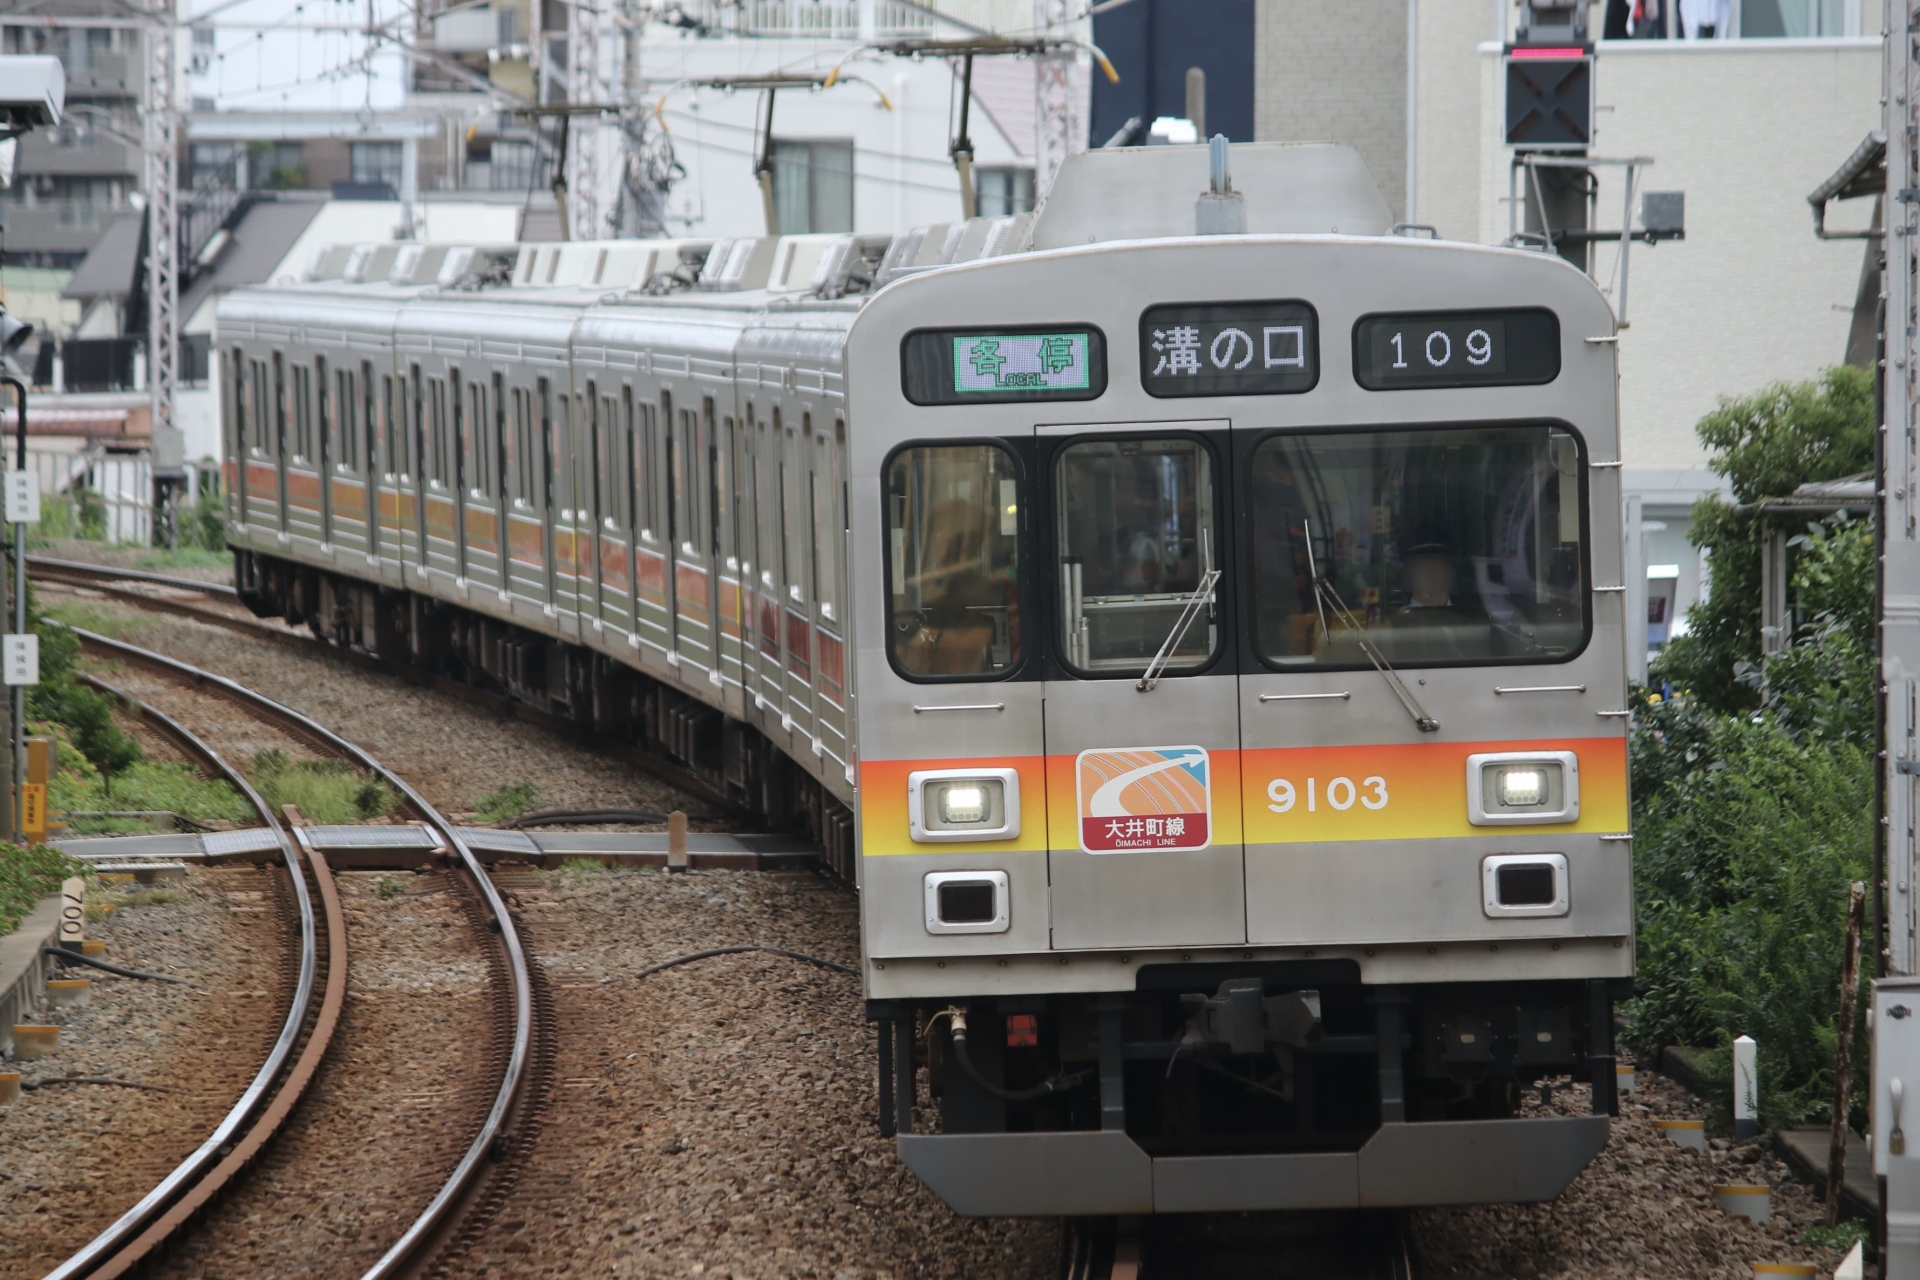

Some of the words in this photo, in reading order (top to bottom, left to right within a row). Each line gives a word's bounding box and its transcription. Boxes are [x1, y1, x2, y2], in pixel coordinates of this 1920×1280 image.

[969, 337, 1073, 376] 各停
[1151, 325, 1305, 377] 溝の口
[1389, 328, 1492, 369] 109
[995, 372, 1048, 387] LOCAL
[1267, 775, 1389, 813] 9103
[1104, 817, 1186, 839] 大井町線
[1156, 838, 1177, 847] LINE
[61, 890, 83, 934] 700
